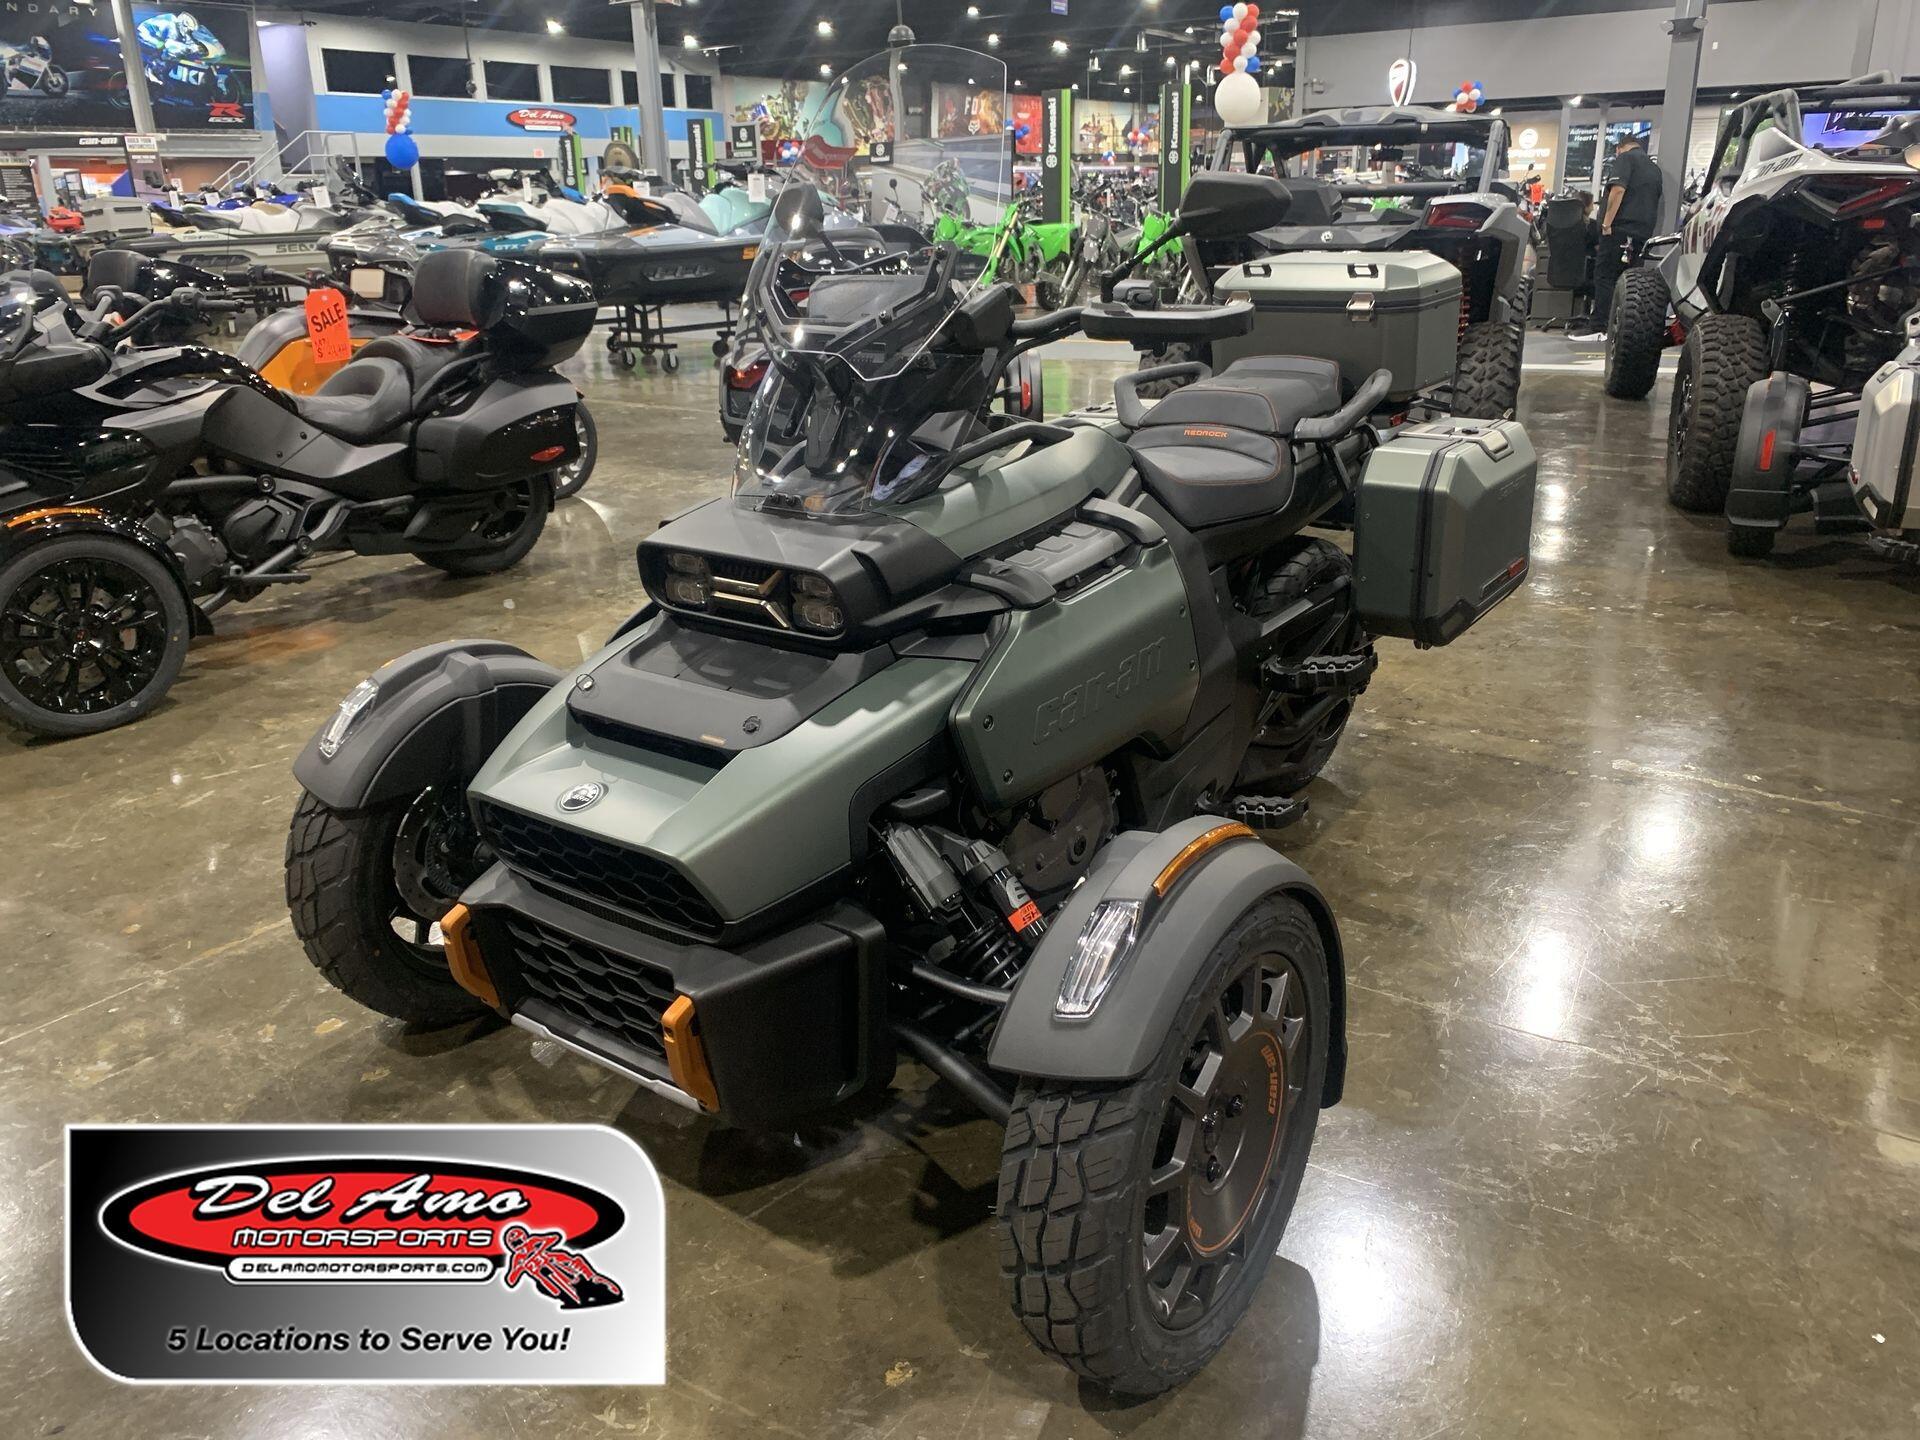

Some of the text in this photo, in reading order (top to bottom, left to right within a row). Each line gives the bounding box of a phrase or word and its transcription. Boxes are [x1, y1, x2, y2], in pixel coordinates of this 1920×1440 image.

[518, 109, 565, 119] Del Amo
[1047, 97, 1057, 153] Kawasaki
[1170, 91, 1179, 149] Kawasaki
[692, 123, 704, 168] Kawasaki
[494, 243, 520, 251] GTX
[311, 302, 344, 333] SALE
[1183, 429, 1229, 438] REDROCK
[1032, 636, 1166, 746] can-am
[1260, 1045, 1278, 1114] can-am
